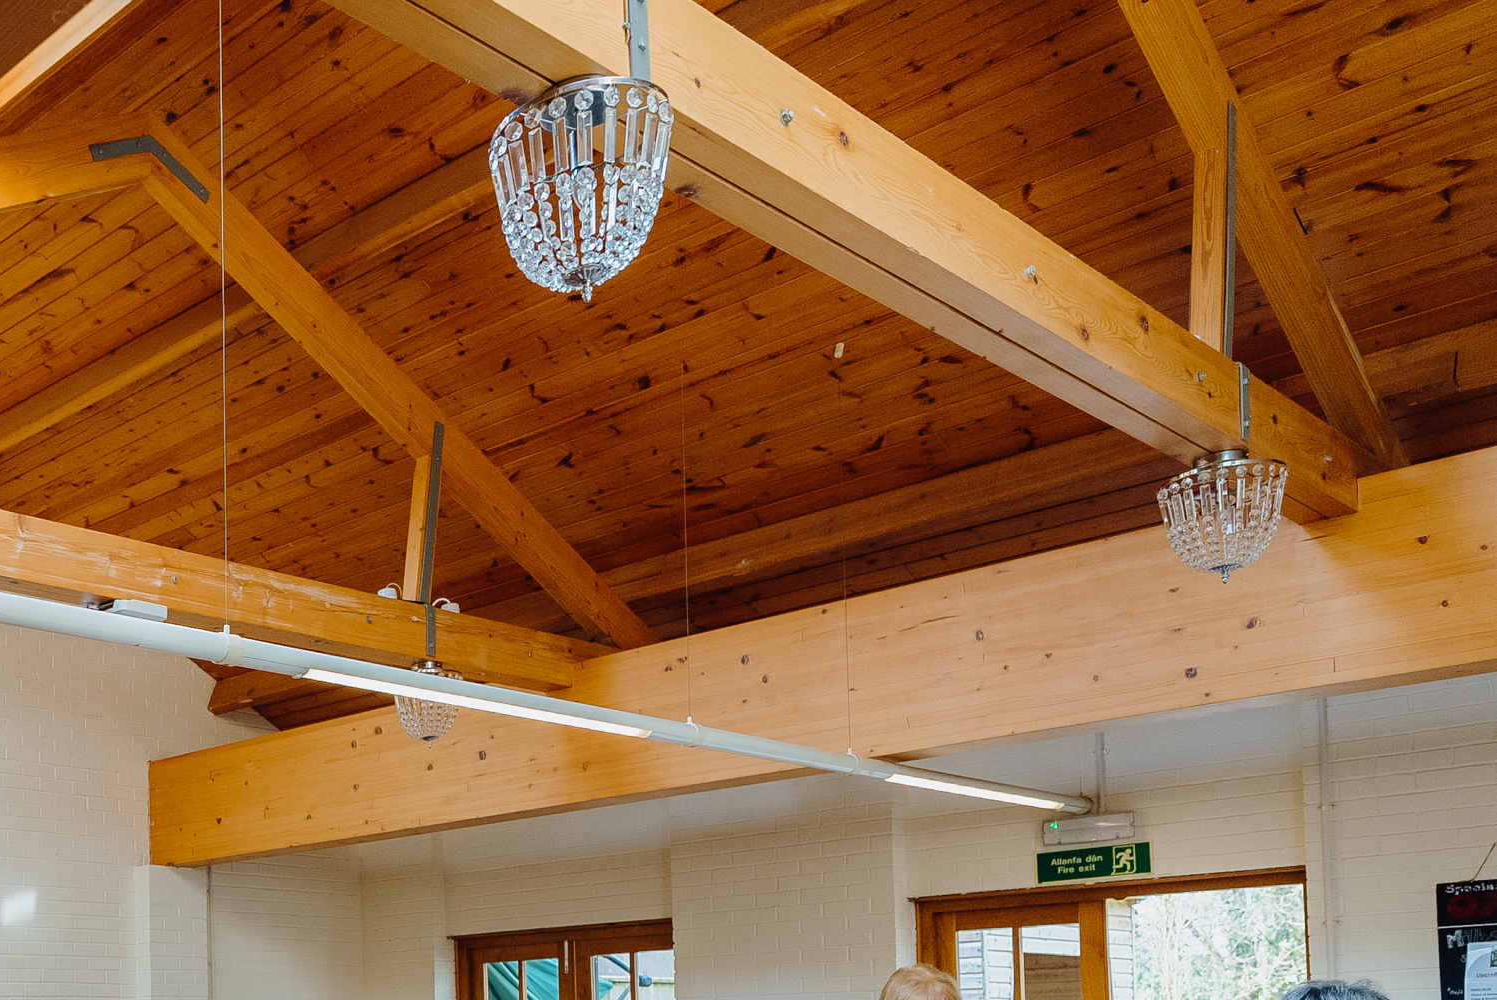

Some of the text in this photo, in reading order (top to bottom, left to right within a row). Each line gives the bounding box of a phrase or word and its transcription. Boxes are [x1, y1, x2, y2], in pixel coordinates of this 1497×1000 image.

[1050, 856, 1082, 866] Allanfa
[1057, 864, 1096, 874] Fire exit
[1445, 883, 1497, 896] Specia
